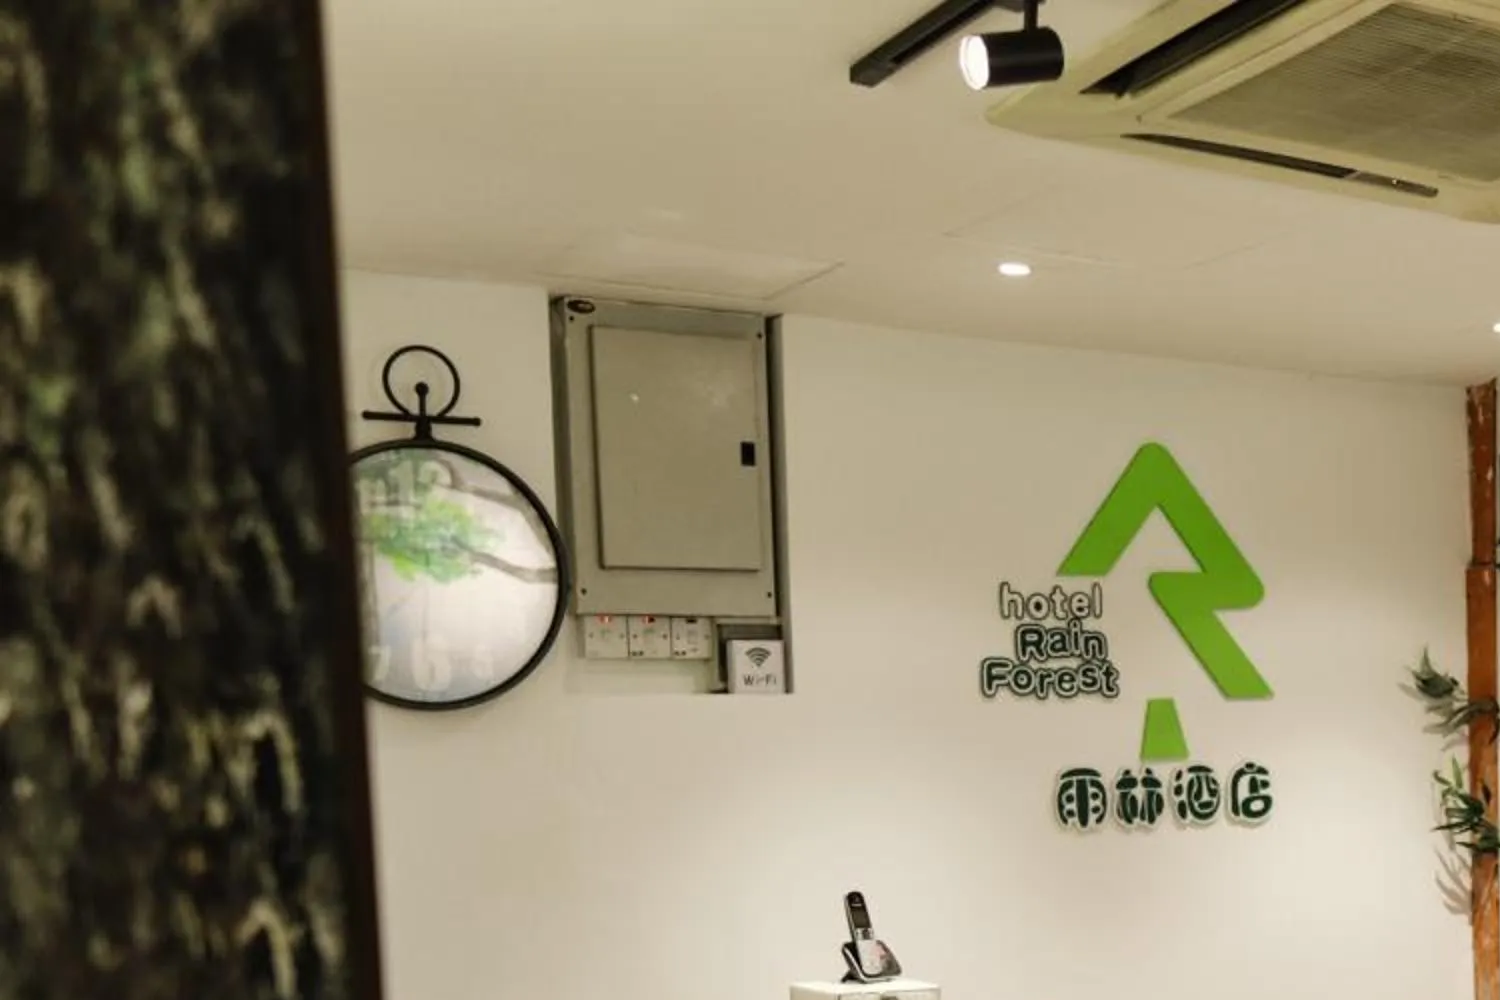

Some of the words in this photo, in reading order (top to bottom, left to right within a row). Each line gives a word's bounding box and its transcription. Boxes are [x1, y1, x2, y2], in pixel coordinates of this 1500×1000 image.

[1000, 581, 1103, 620] hotel
[1015, 617, 1109, 664] Rain
[981, 657, 1120, 699] Forest
[1056, 761, 1273, 828] 雨林酒店
